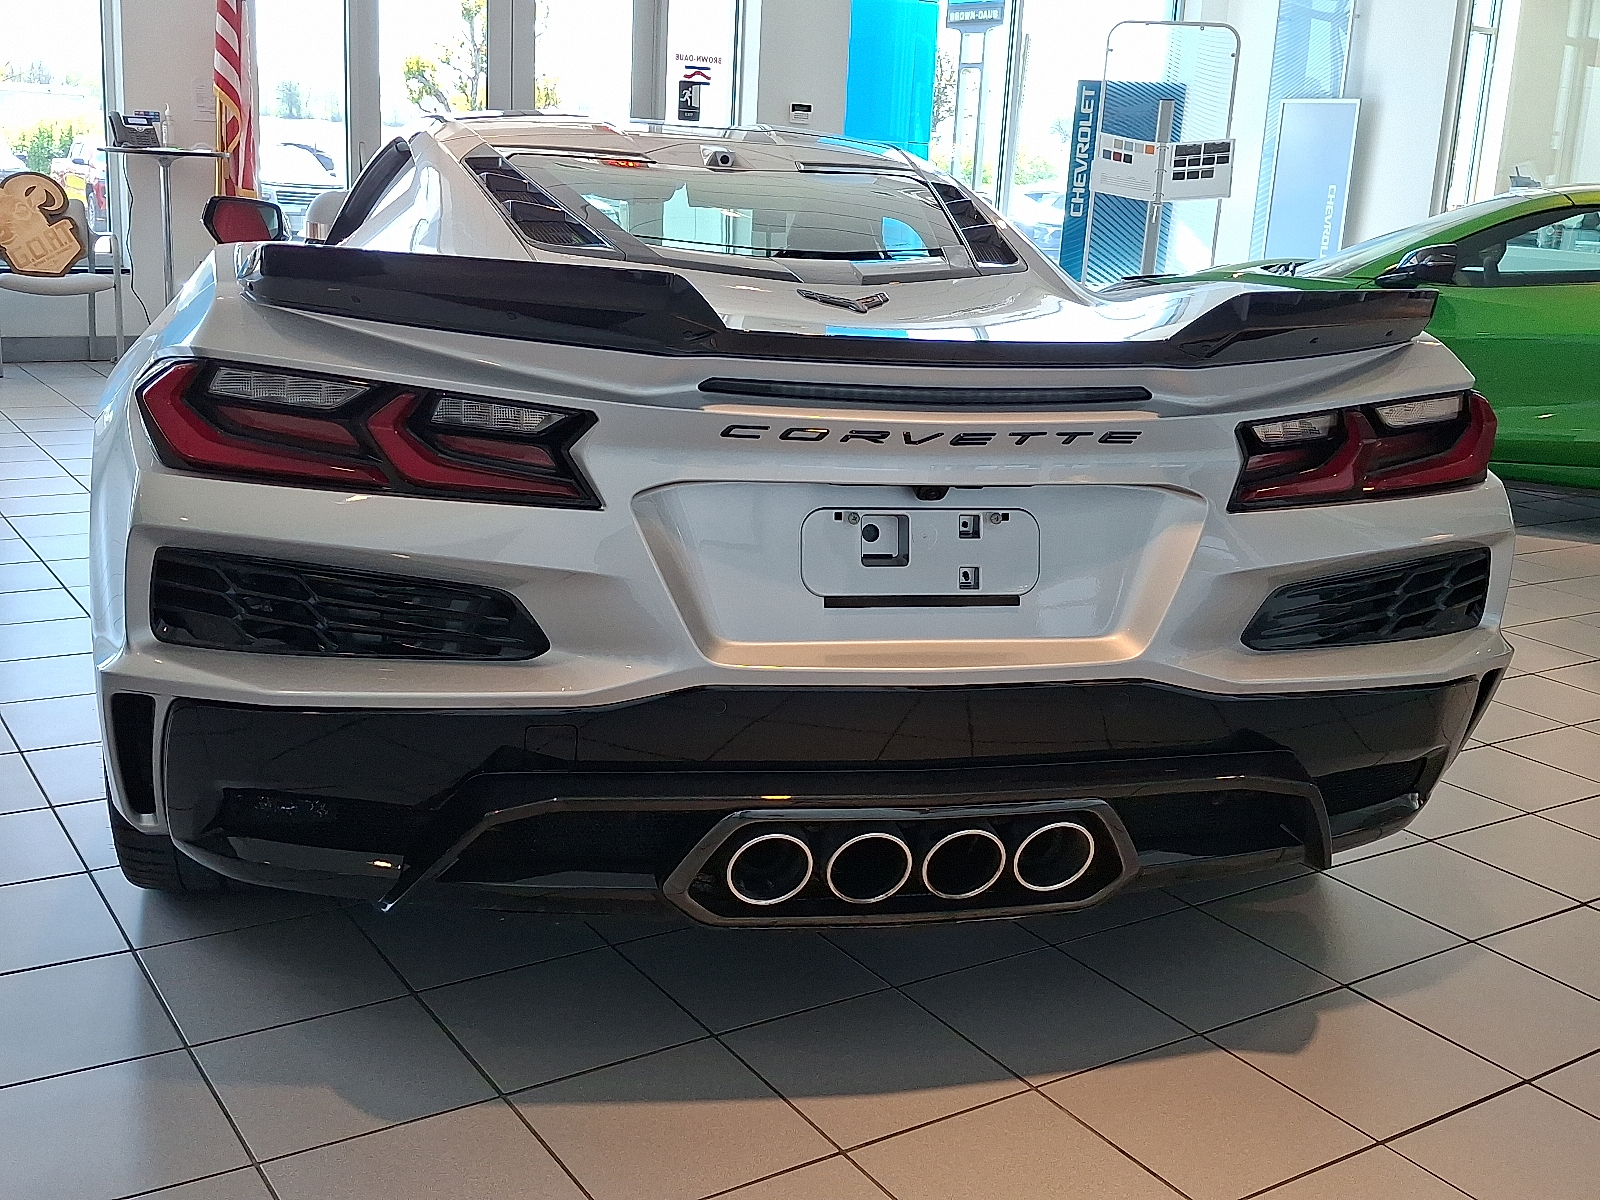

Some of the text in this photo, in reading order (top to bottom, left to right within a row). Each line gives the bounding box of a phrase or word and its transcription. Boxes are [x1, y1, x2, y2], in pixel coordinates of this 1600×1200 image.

[949, 9, 999, 21] BROWN-DAUB
[1069, 85, 1096, 217] CHEVROLET
[1319, 184, 1337, 259] CHEVROL
[719, 423, 1144, 447] CORVETTE
